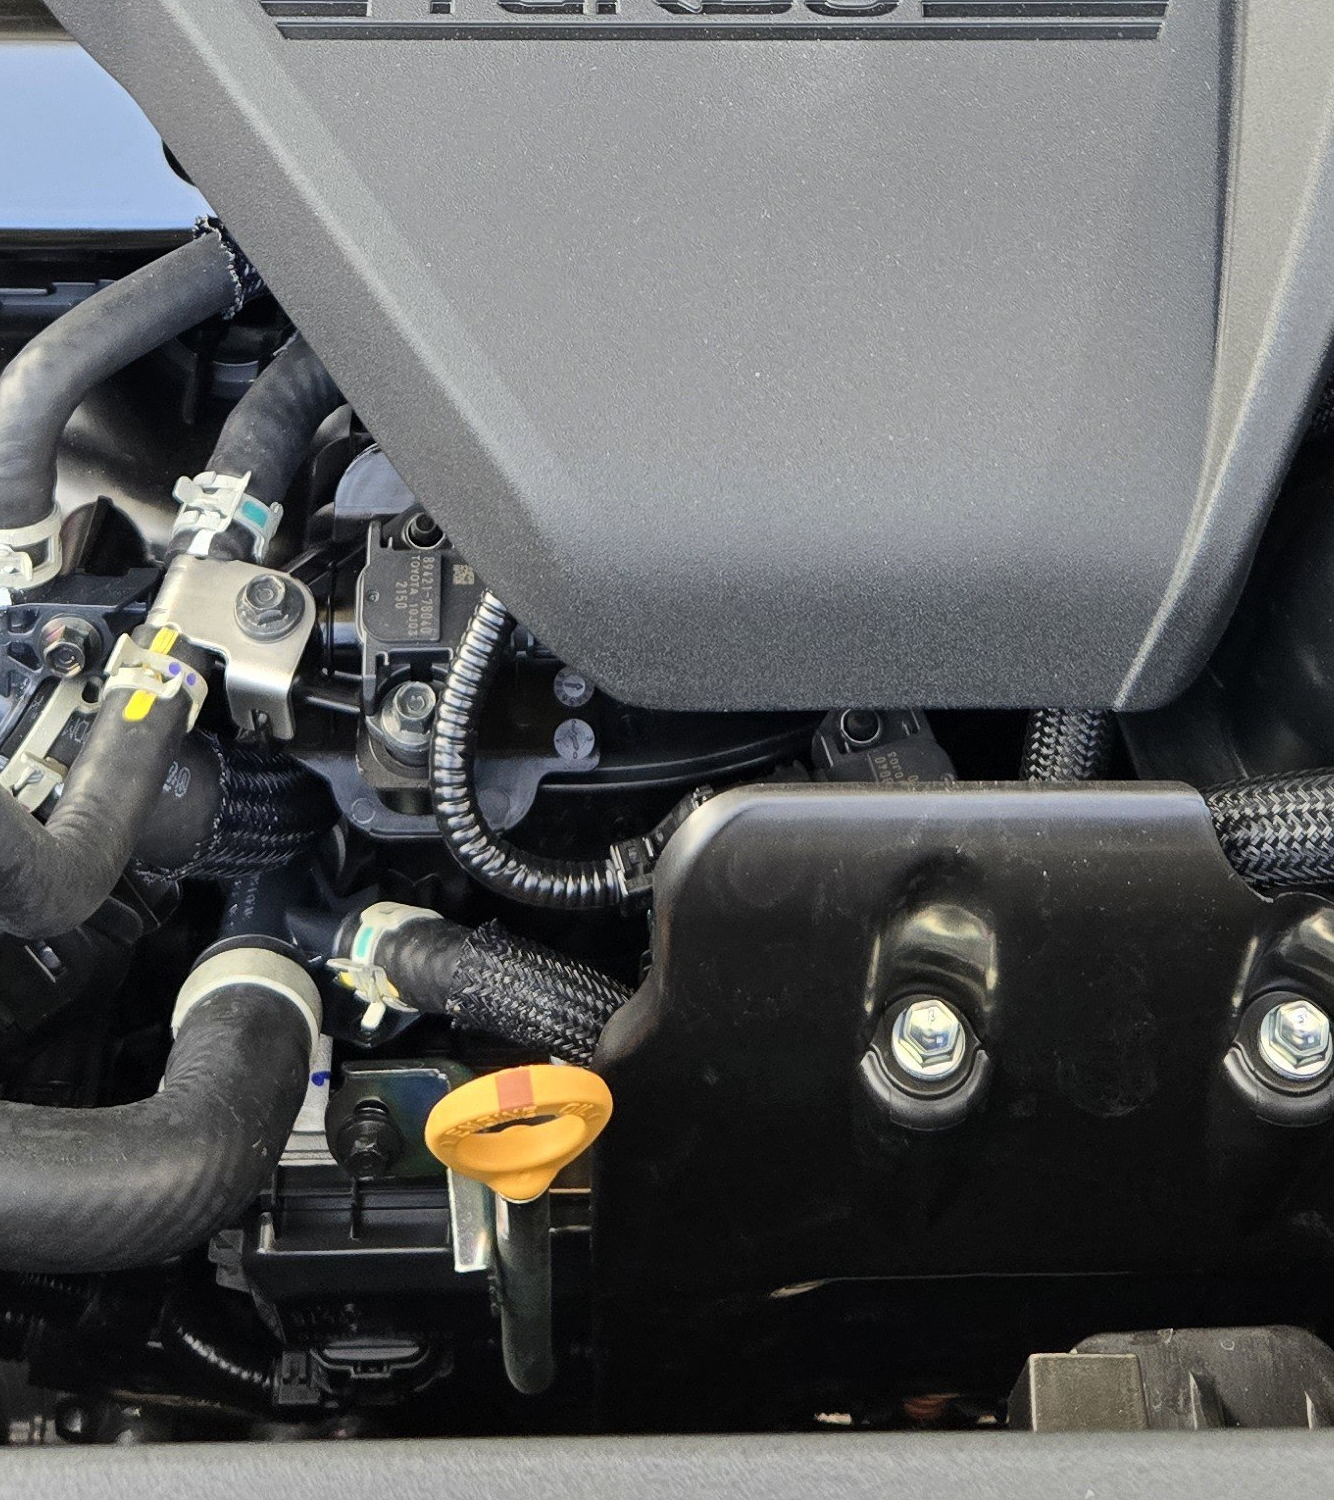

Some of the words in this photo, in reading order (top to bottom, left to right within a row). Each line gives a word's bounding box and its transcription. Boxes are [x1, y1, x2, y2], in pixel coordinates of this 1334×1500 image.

[408, 555, 421, 595] TOYOTA
[394, 580, 408, 610] 2150
[419, 556, 435, 634] 89421-78040
[444, 1104, 538, 1138] ENGINE
[558, 1101, 595, 1116] OIL
